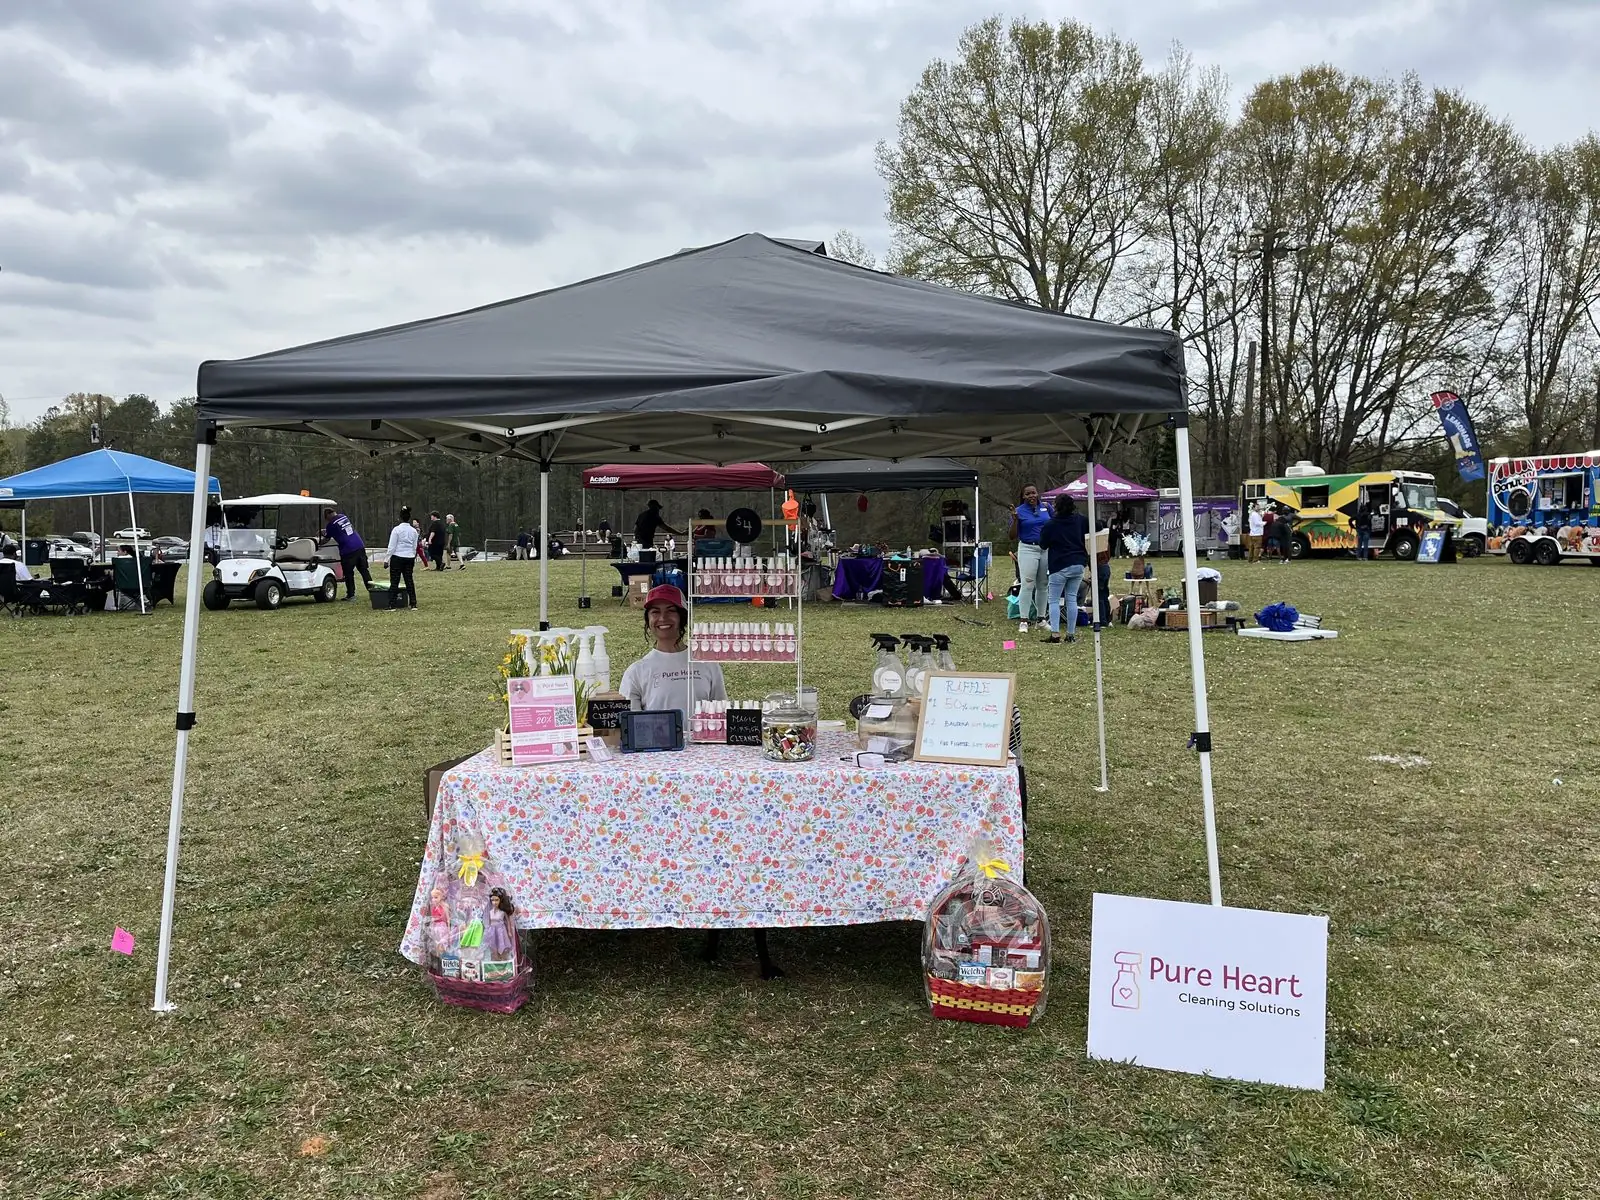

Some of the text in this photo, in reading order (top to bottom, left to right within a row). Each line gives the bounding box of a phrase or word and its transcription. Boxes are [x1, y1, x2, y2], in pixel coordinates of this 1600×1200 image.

[1445, 413, 1473, 449] LEMONADE
[536, 716, 552, 725] 20%
[1149, 957, 1304, 998] Pure Heart
[1178, 993, 1301, 1017] Cleaning Solutions
